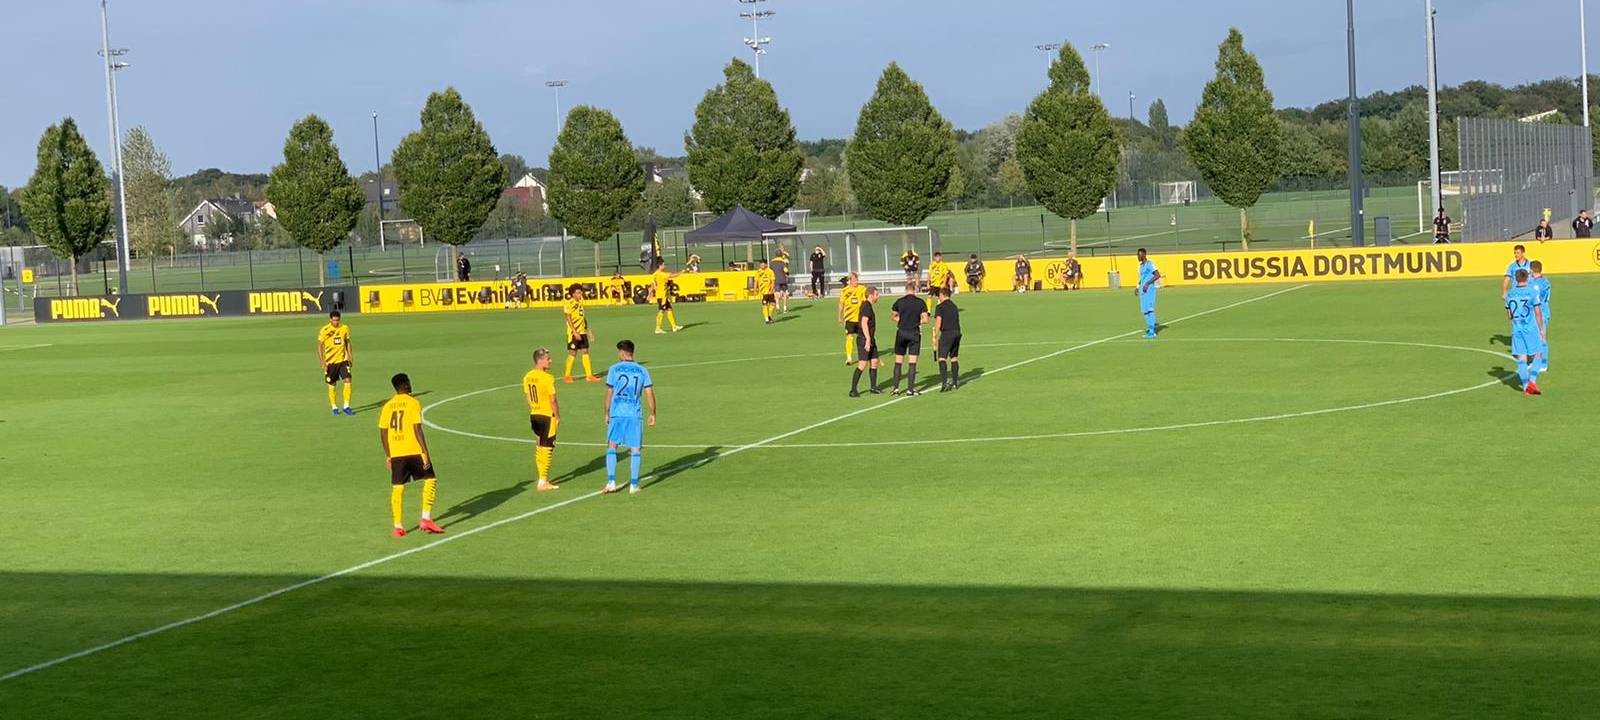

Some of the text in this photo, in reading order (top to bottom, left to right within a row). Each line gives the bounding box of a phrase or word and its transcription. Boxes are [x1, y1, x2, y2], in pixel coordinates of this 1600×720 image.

[1182, 250, 1463, 280] BORUSSIA DORTMUND
[51, 298, 101, 319] PUMA
[148, 295, 200, 316] PUMA
[250, 291, 302, 313] PUMA
[1508, 299, 1531, 319] 23
[528, 384, 539, 405] 10
[616, 374, 639, 397] 21
[390, 410, 404, 431] 47
